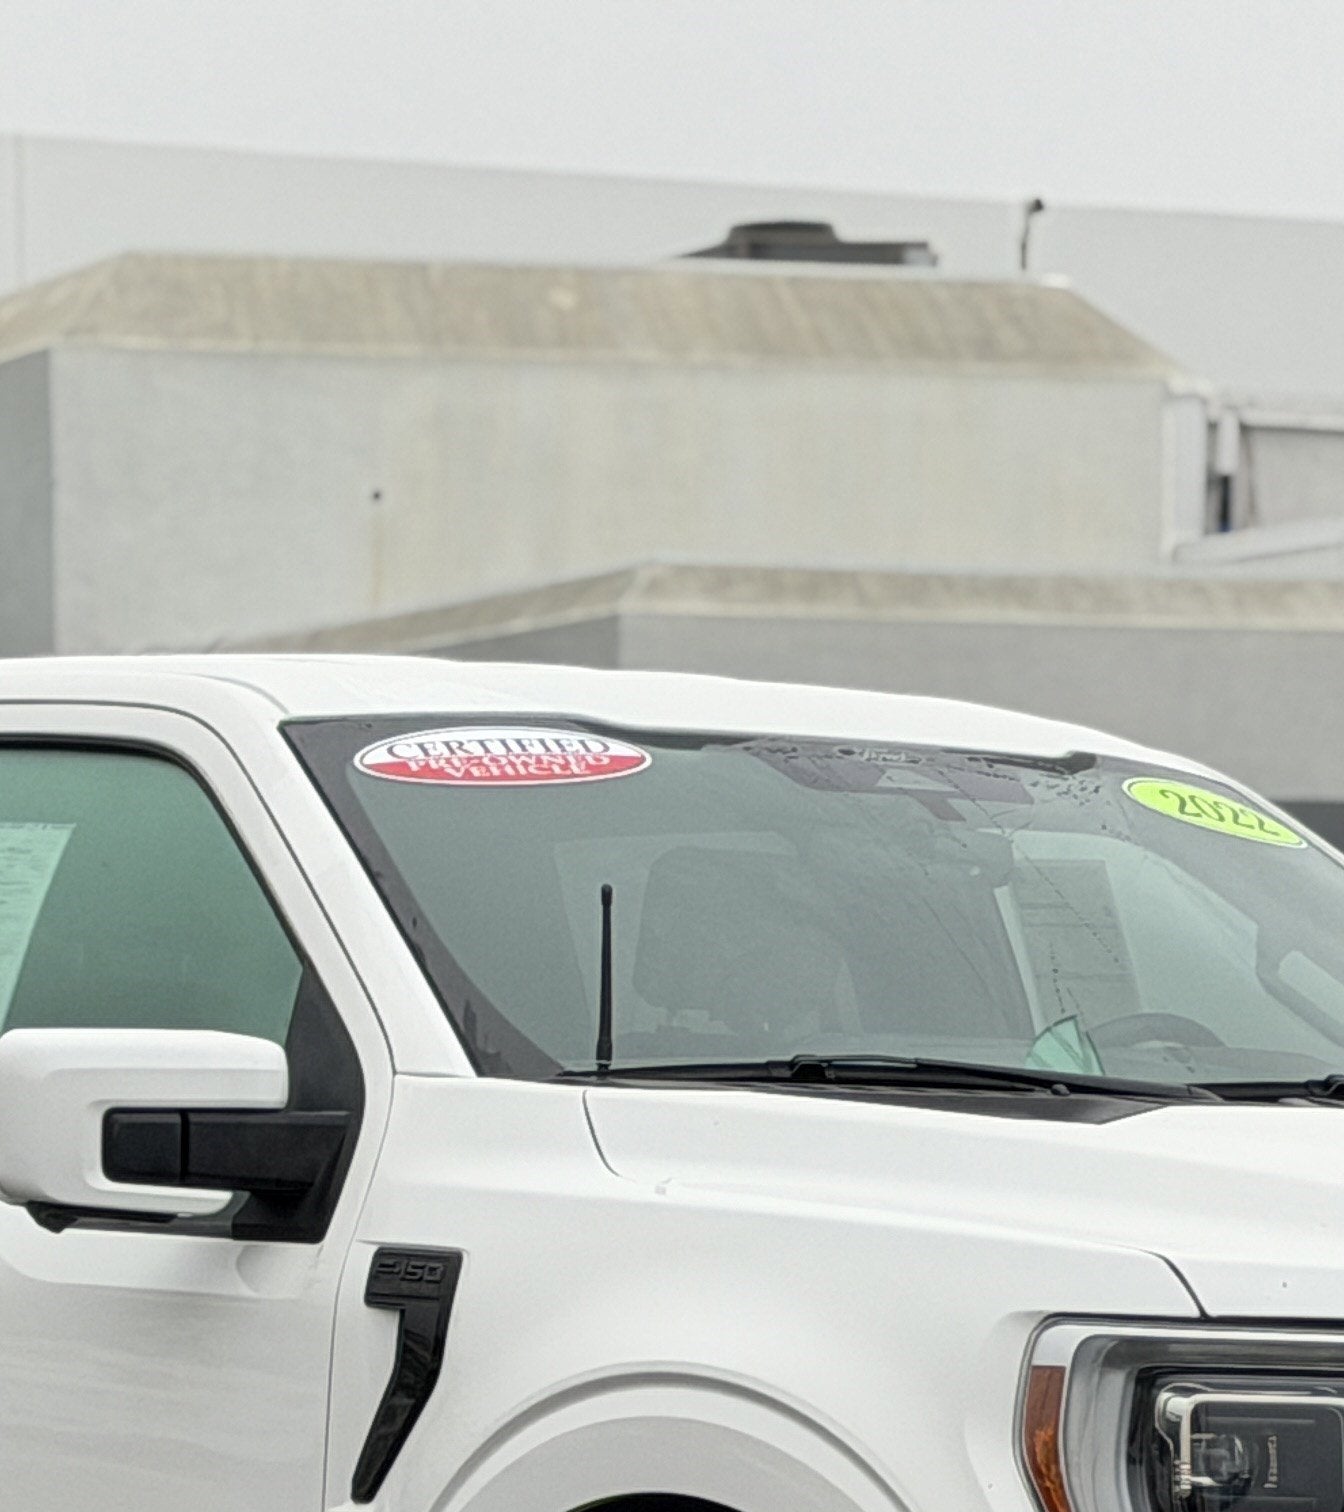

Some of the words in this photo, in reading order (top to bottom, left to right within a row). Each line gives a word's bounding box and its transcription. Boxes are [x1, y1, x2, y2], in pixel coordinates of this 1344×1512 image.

[387, 738, 610, 759] CERTIFIED
[444, 763, 592, 778] VEHICLE
[1158, 788, 1281, 837] 2022
